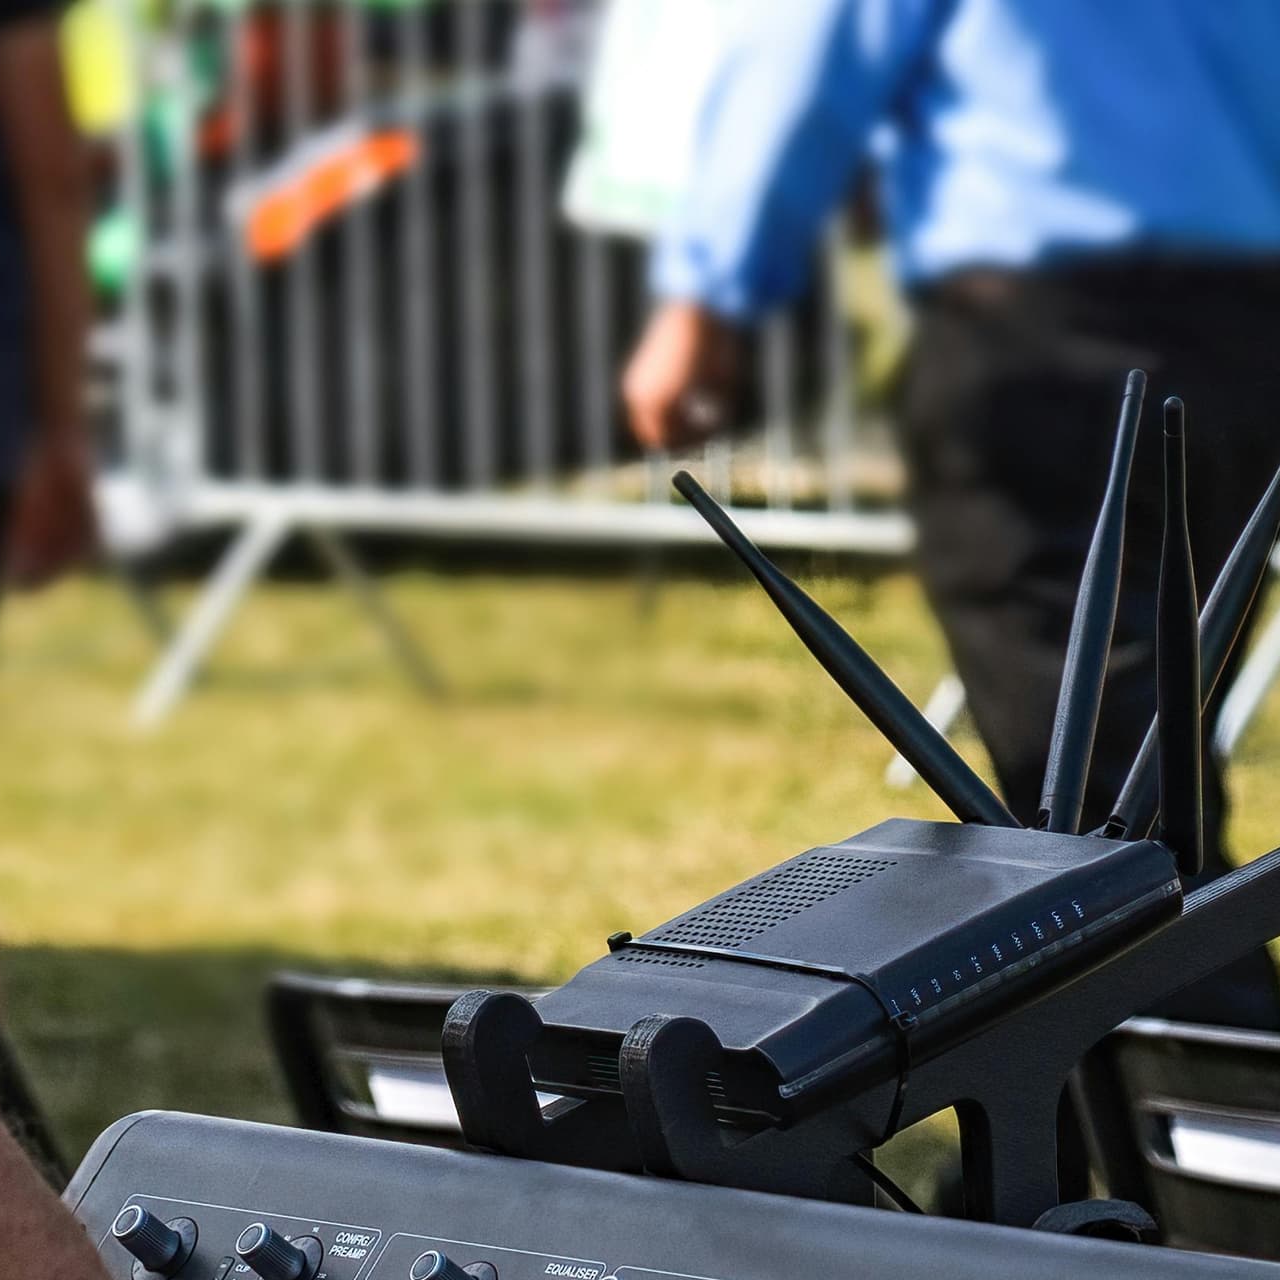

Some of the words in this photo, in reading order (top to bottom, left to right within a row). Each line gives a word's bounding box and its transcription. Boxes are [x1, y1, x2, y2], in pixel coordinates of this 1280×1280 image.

[991, 943, 1003, 961] WAN
[910, 987, 922, 1006] WPS
[335, 1231, 376, 1247] CONFIG/
[328, 1245, 367, 1260] PREAMP
[235, 1263, 251, 1273] CLIP
[544, 1263, 599, 1280] EQUALISER
